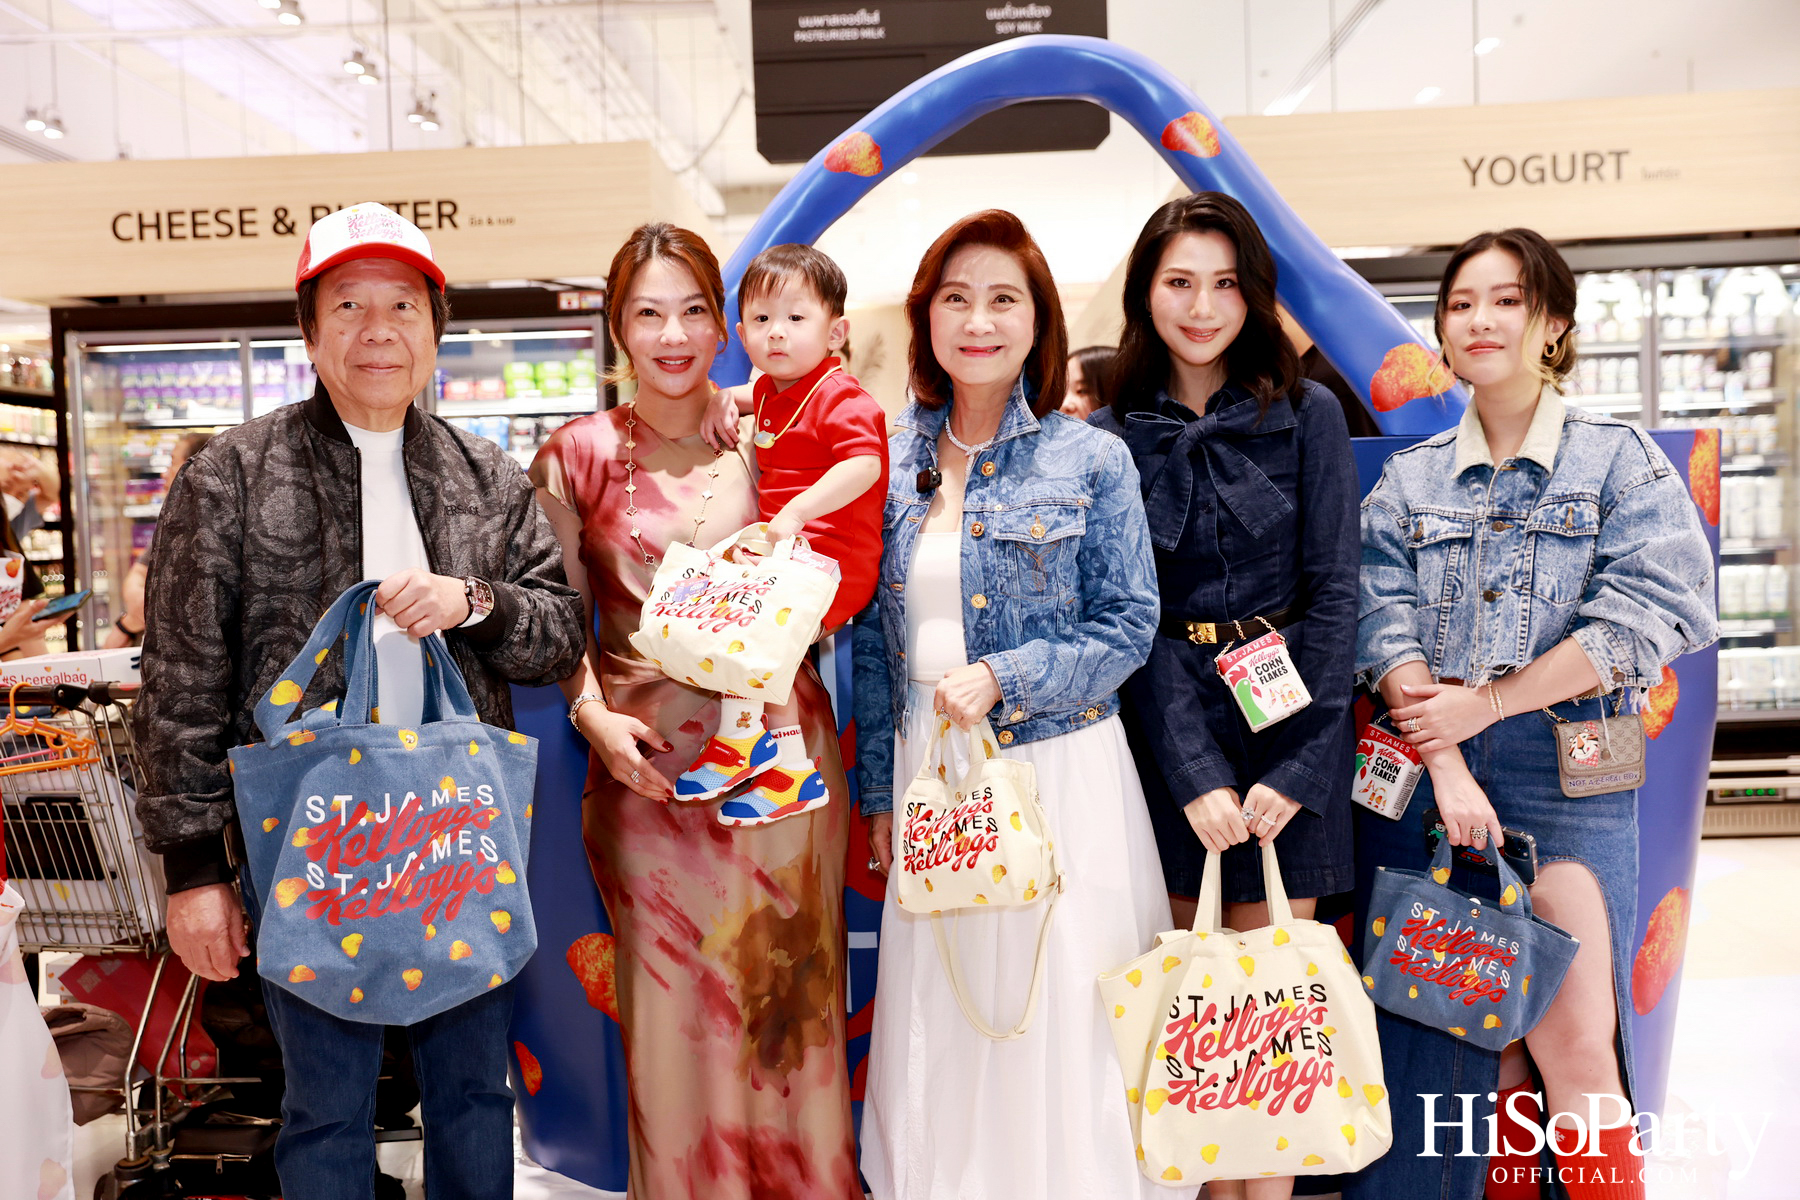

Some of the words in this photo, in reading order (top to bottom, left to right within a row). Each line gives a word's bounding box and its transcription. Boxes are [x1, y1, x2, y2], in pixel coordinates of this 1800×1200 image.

[794, 28, 859, 42] PASTEURIZED
[860, 26, 886, 39] MILK
[995, 21, 1015, 34] SOY
[1017, 20, 1043, 33] MILK
[1462, 149, 1630, 188] YOGURT
[112, 208, 258, 242] CHEESE
[273, 207, 296, 235] &
[1226, 636, 1273, 663] ST.JAMES
[1249, 647, 1280, 668] Kellogg's
[1254, 656, 1284, 676] CORN
[1259, 665, 1289, 685] FLAKES
[1369, 729, 1410, 753] ST.JAMES
[1371, 766, 1398, 784] FLAKES
[1375, 756, 1402, 775] CORN
[306, 784, 494, 826] ST.JAMES
[306, 799, 497, 875] Kellogg's
[904, 826, 999, 875] Kellogg's
[306, 830, 499, 896] ST.JAMES
[306, 852, 499, 926] Kellogg's
[1401, 918, 1517, 967] Kellogg's
[1411, 902, 1520, 955] ST.JAMES
[1389, 950, 1507, 1006] Kellogg's
[1397, 935, 1510, 988] ST.JAMES
[1169, 983, 1327, 1025] ST.JAMES
[1164, 996, 1329, 1068] Kellogg's
[1166, 1027, 1333, 1088] ST.JAMES
[1167, 1046, 1335, 1116] Kellogg's
